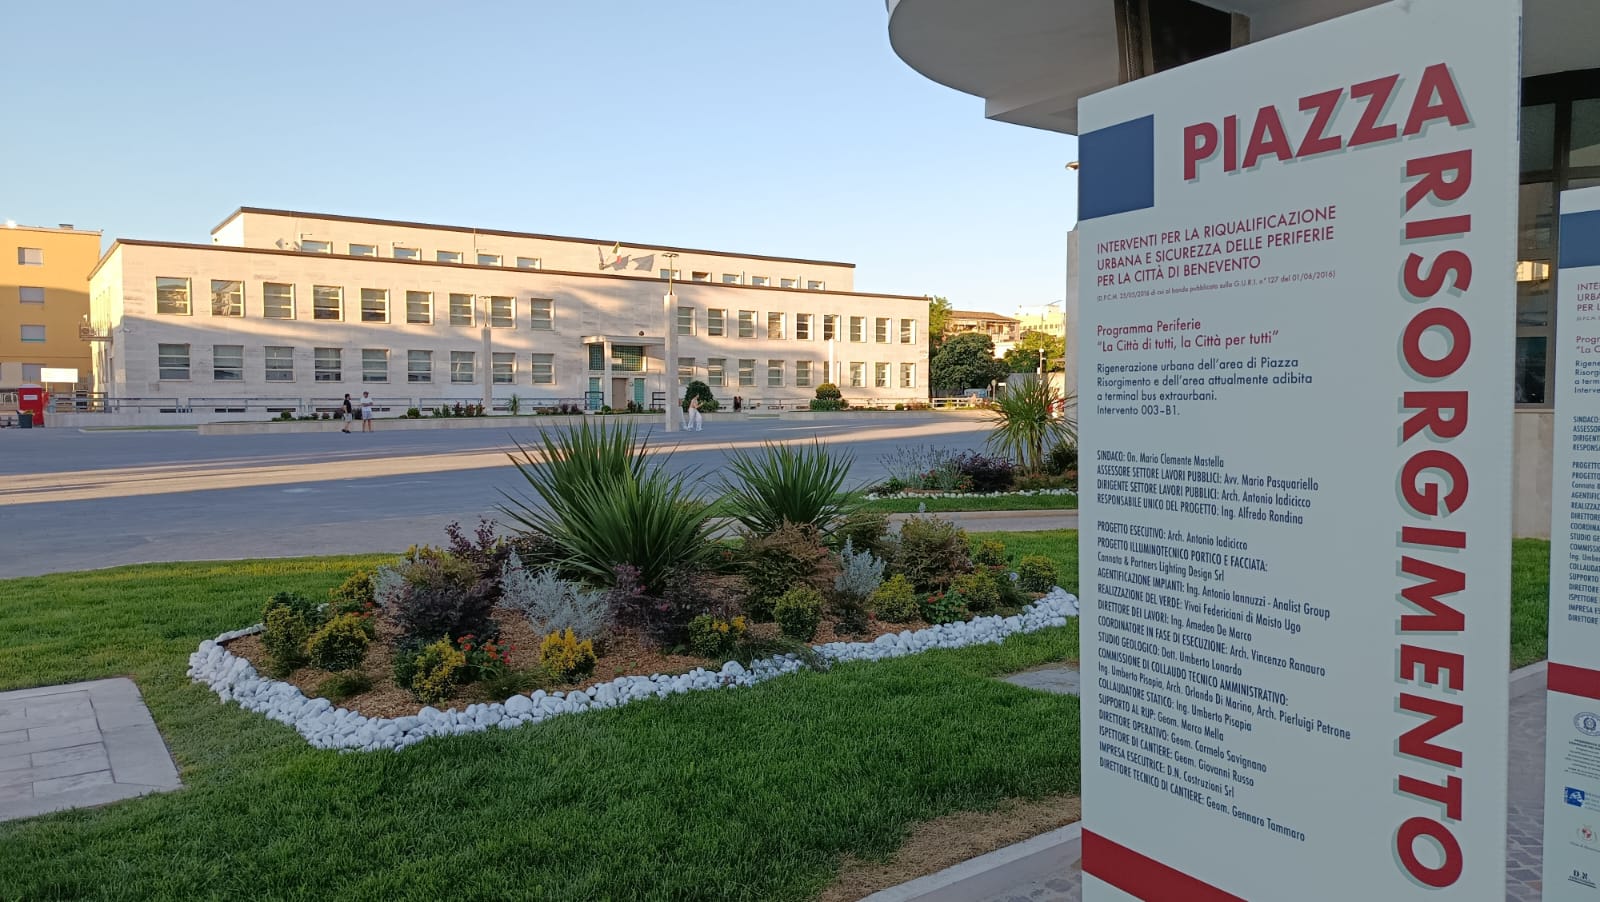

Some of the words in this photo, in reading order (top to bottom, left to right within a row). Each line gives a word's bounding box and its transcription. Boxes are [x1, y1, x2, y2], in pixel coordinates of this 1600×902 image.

[1184, 62, 1471, 181] PIAZZA
[1097, 234, 1157, 254] INTERVENTI
[1160, 230, 1180, 244] PER
[1184, 228, 1199, 240] LA
[1203, 205, 1336, 238] RIQUALIFICAZIONE
[1097, 254, 1142, 270] URBANA
[1145, 252, 1151, 264] E
[1155, 242, 1221, 265] SICUREZZA
[1225, 236, 1262, 252] DELLE
[1267, 226, 1334, 247] PERIFERIE
[1097, 274, 1115, 286] PER
[1117, 272, 1131, 284] LA
[1134, 266, 1164, 282] CITTÀ
[1167, 265, 1179, 278] DI
[1183, 255, 1260, 276] BENEVENTO
[1577, 303, 1593, 312] PER
[1096, 324, 1153, 337] Programma
[1156, 318, 1200, 332] Periferie
[1116, 337, 1139, 350] Città
[1141, 337, 1151, 349] di
[1180, 335, 1191, 348] la
[1194, 334, 1221, 346] Città
[1224, 336, 1245, 349] per
[1096, 361, 1158, 377] Rigenerazione
[1160, 360, 1194, 375] urbana
[1246, 356, 1256, 368] di
[1260, 356, 1298, 371] Piazza
[1096, 374, 1151, 389] Risorgimento
[1153, 378, 1159, 386] e
[1207, 372, 1268, 385] attualmente
[1272, 372, 1312, 384] adibita
[1096, 404, 1139, 414] Intervento
[1104, 388, 1138, 400] terminal
[1140, 389, 1156, 400] bus
[1096, 464, 1130, 476] ASSESSORE
[1131, 466, 1159, 478] SETTORE
[1160, 468, 1185, 480] LAVORI
[1241, 474, 1264, 486] Mario
[1139, 452, 1158, 463] Mario
[1160, 452, 1192, 465] Clemente
[1193, 455, 1224, 467] Mastella
[1096, 478, 1128, 491] DIRIGENTE
[1129, 481, 1157, 494] SETTORE
[1158, 484, 1183, 496] LAVORI
[1241, 490, 1273, 504] Antonio
[1096, 493, 1141, 507] RESPONSABILE
[1142, 497, 1164, 510] UNICO
[1165, 499, 1178, 511] DEL
[1237, 506, 1266, 520] Alfredo
[1096, 520, 1128, 534] PROGETTO
[1185, 532, 1214, 546] Antonio
[1397, 148, 1473, 889] RISORGIMENTO
[1096, 536, 1128, 550] PROGETTO
[1129, 541, 1189, 560] ILLUMINOTECNICO
[1190, 549, 1221, 564] PORTICO
[1223, 554, 1228, 566] E
[1097, 583, 1143, 601] REALIZZAZIONE
[1144, 592, 1158, 604] DEL
[1183, 599, 1201, 612] Vivai
[1203, 603, 1243, 620] Federiciani
[1245, 610, 1253, 622] di
[1255, 613, 1282, 628] Maisto
[1284, 618, 1301, 634] Ugo
[1097, 599, 1130, 615] DIRETTORE
[1131, 606, 1142, 617] DEI
[1185, 617, 1215, 633] Amedeo
[1216, 623, 1227, 636] De
[1228, 626, 1252, 641] Marco
[1097, 615, 1144, 635] COORDINATORE
[1145, 626, 1153, 637] IN
[1155, 628, 1171, 641] FASE
[1172, 632, 1180, 643] DI
[1250, 649, 1286, 667] Vincenzo
[1097, 647, 1140, 667] COMMISSIONE
[1141, 658, 1149, 670] DI
[1150, 660, 1186, 679] COLLAUDO
[1188, 670, 1218, 687] TECNICO
[1098, 677, 1144, 700] COLLAUDATORE
[1191, 704, 1222, 722] Umberto
[1111, 665, 1137, 681] Umberto
[1215, 693, 1223, 704] Di
[1279, 710, 1314, 731] Pierluigi
[1316, 720, 1350, 739] Petrone
[1098, 709, 1130, 728] DIRETTORE
[1194, 740, 1224, 758] Carmelo
[1099, 741, 1125, 758] IMPRESA
[1183, 770, 1222, 793] Costruzioni
[1223, 784, 1234, 798] Srl
[1099, 756, 1131, 777] DIRETTORE
[1132, 768, 1159, 787] TECNICO
[1160, 779, 1168, 790] DI
